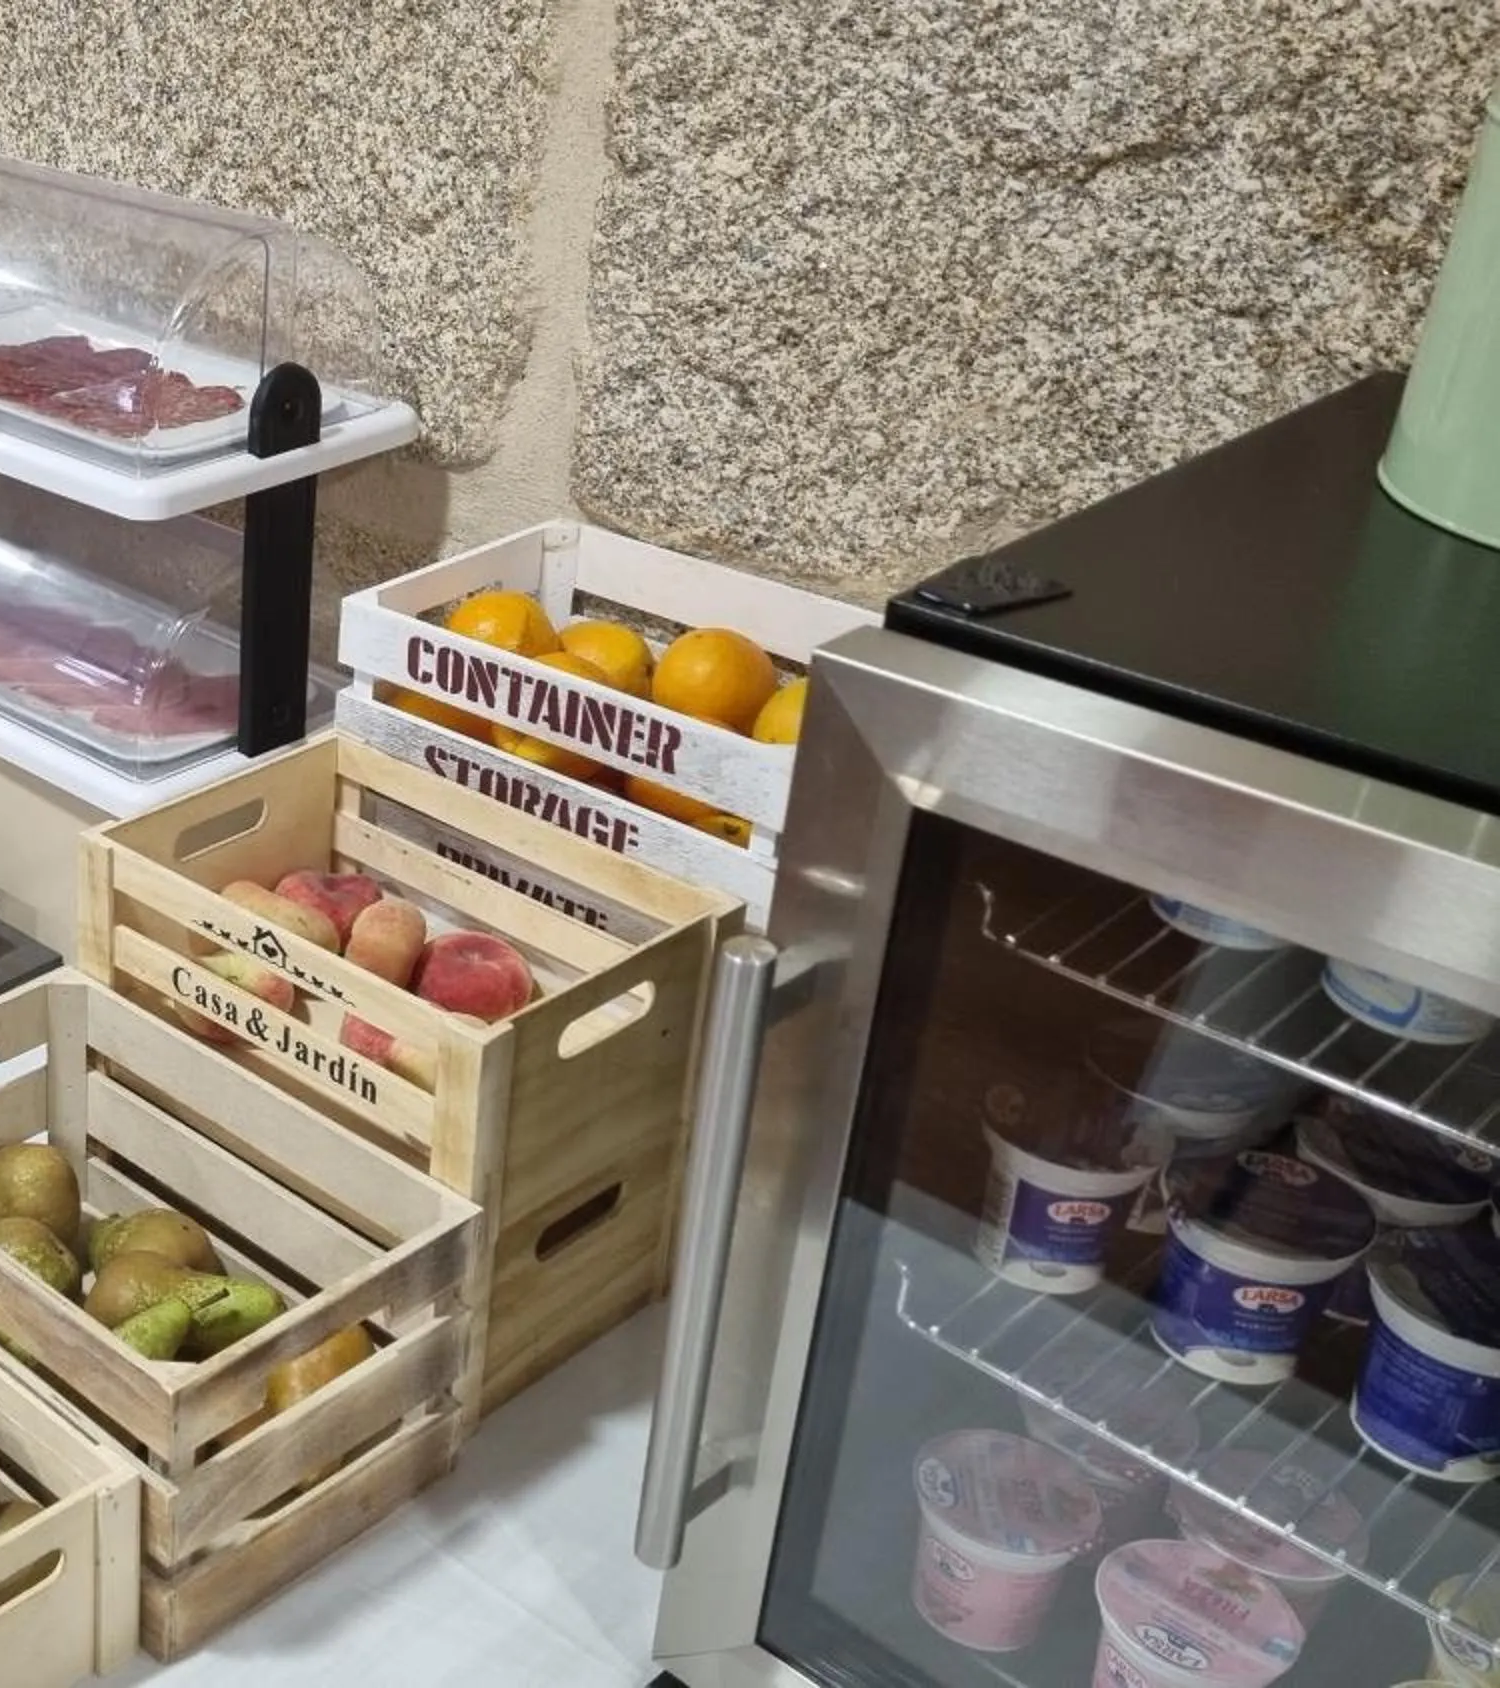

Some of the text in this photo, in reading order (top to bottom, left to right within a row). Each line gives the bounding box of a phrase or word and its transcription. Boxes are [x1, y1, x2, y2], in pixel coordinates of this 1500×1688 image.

[407, 635, 682, 774] CONTAINER
[424, 745, 639, 853] STORAGE
[172, 966, 378, 1104] Casa & Jardín
[1241, 1288, 1298, 1307] LARSA
